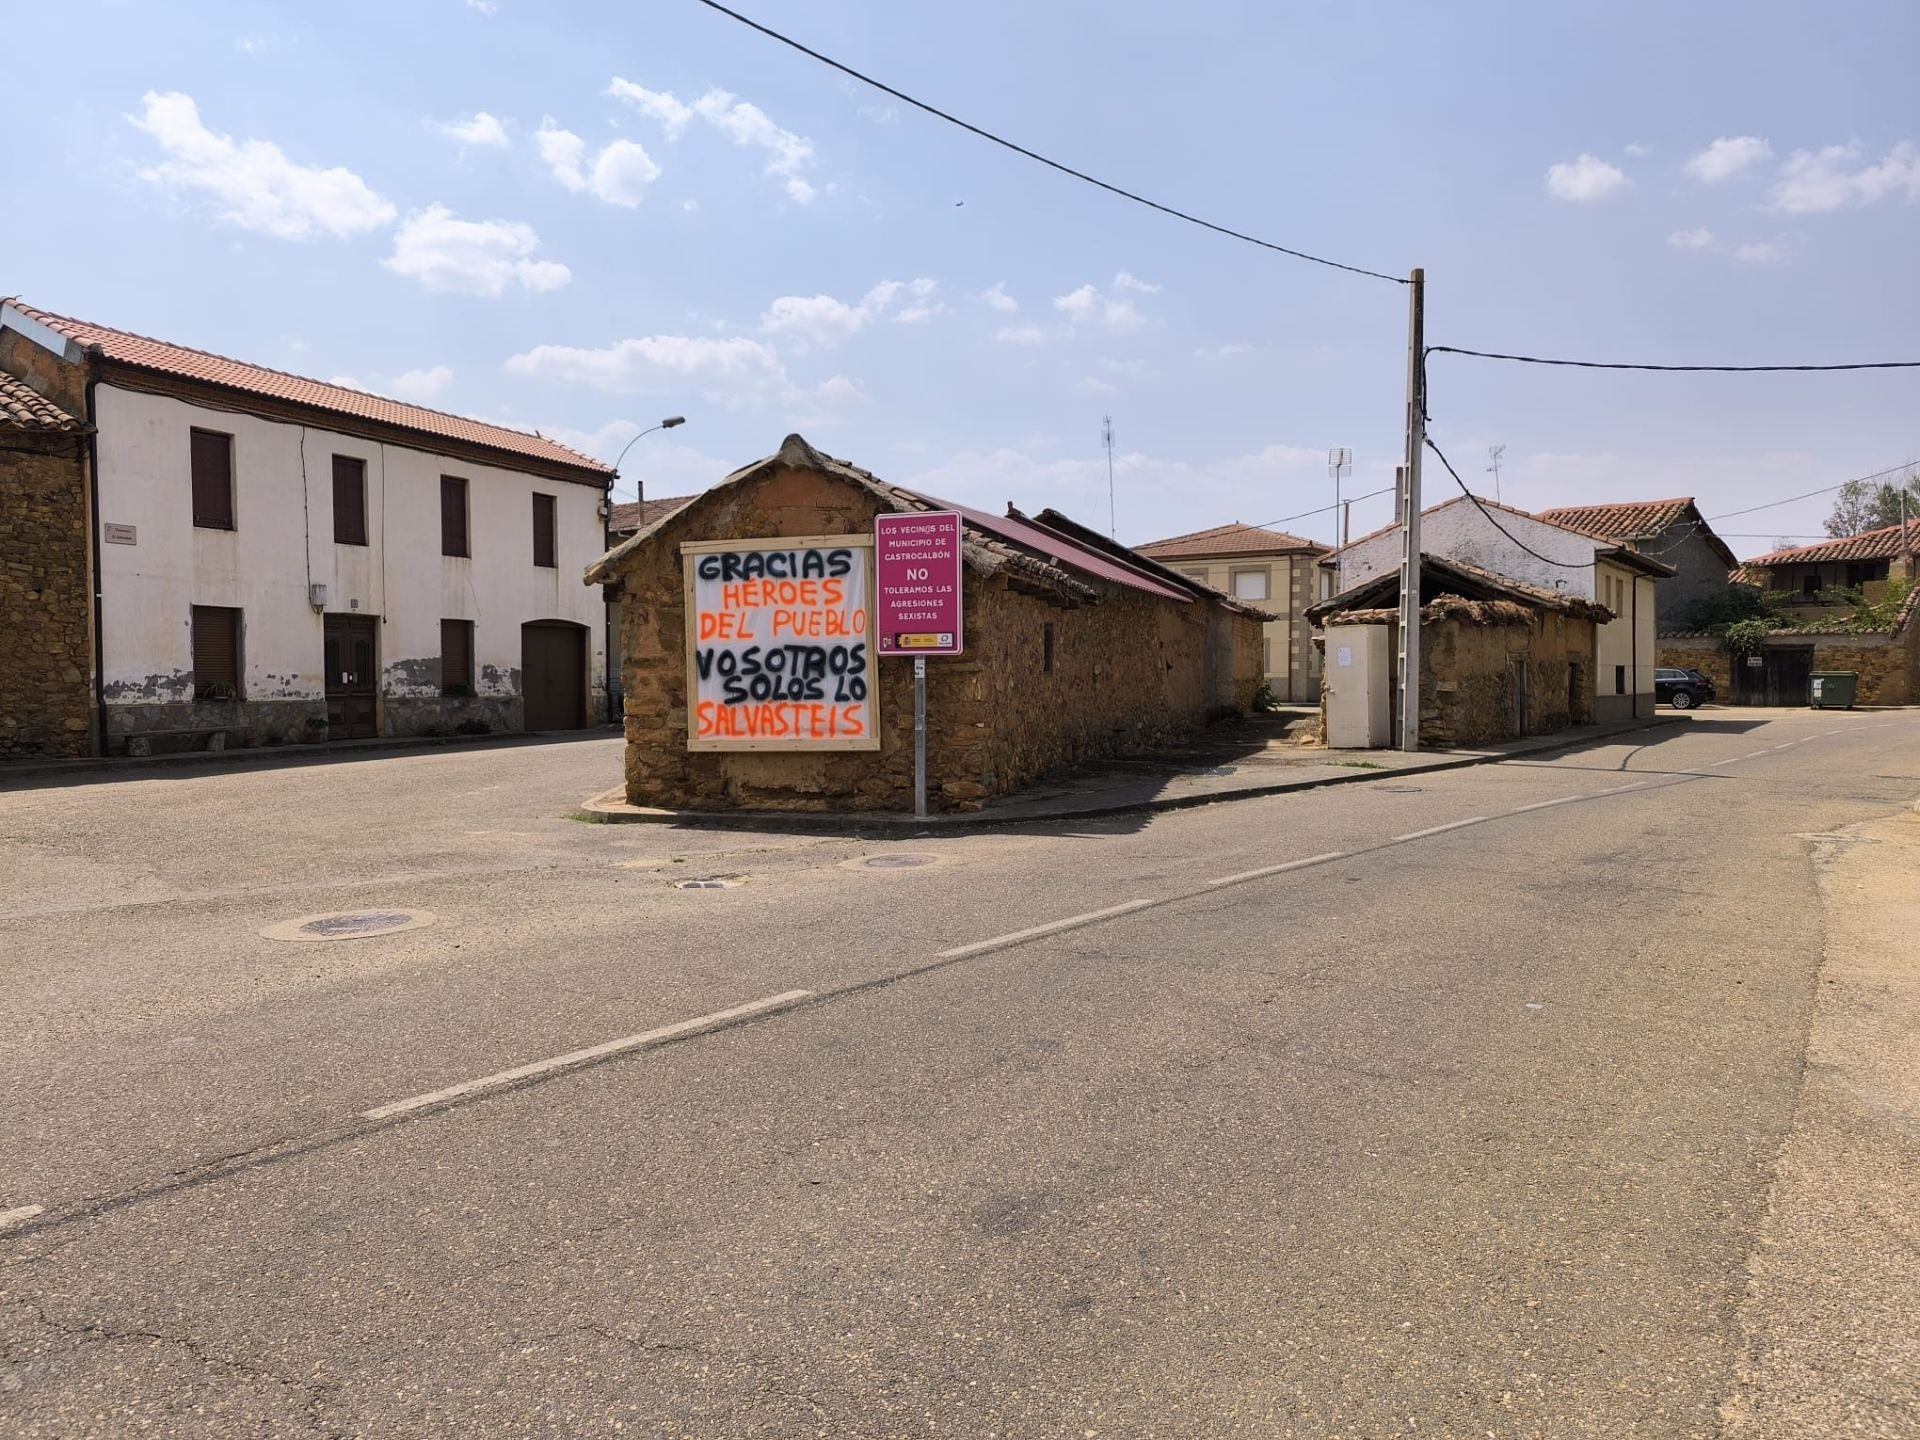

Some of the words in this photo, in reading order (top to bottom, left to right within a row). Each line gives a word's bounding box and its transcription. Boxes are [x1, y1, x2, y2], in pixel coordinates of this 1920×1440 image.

[881, 527, 897, 535] LOS
[939, 524, 955, 532] DEL
[888, 538, 932, 548] MUNICIPIO
[935, 538, 947, 546] DE
[884, 550, 950, 561] CASTROCALBÓN
[699, 549, 852, 581] GRACIAS
[906, 568, 929, 581] NO
[723, 578, 844, 609] HÉROES
[883, 586, 933, 594] TOLERAMOS
[936, 585, 952, 593] LAS
[890, 599, 944, 608] AGRESIONES
[898, 612, 938, 620] SEXISTAS
[700, 612, 754, 640] DEL
[772, 609, 866, 637] PUEBLO
[696, 643, 866, 680] VOSOTROS
[723, 673, 825, 705] SOLOS
[834, 675, 867, 702] LO
